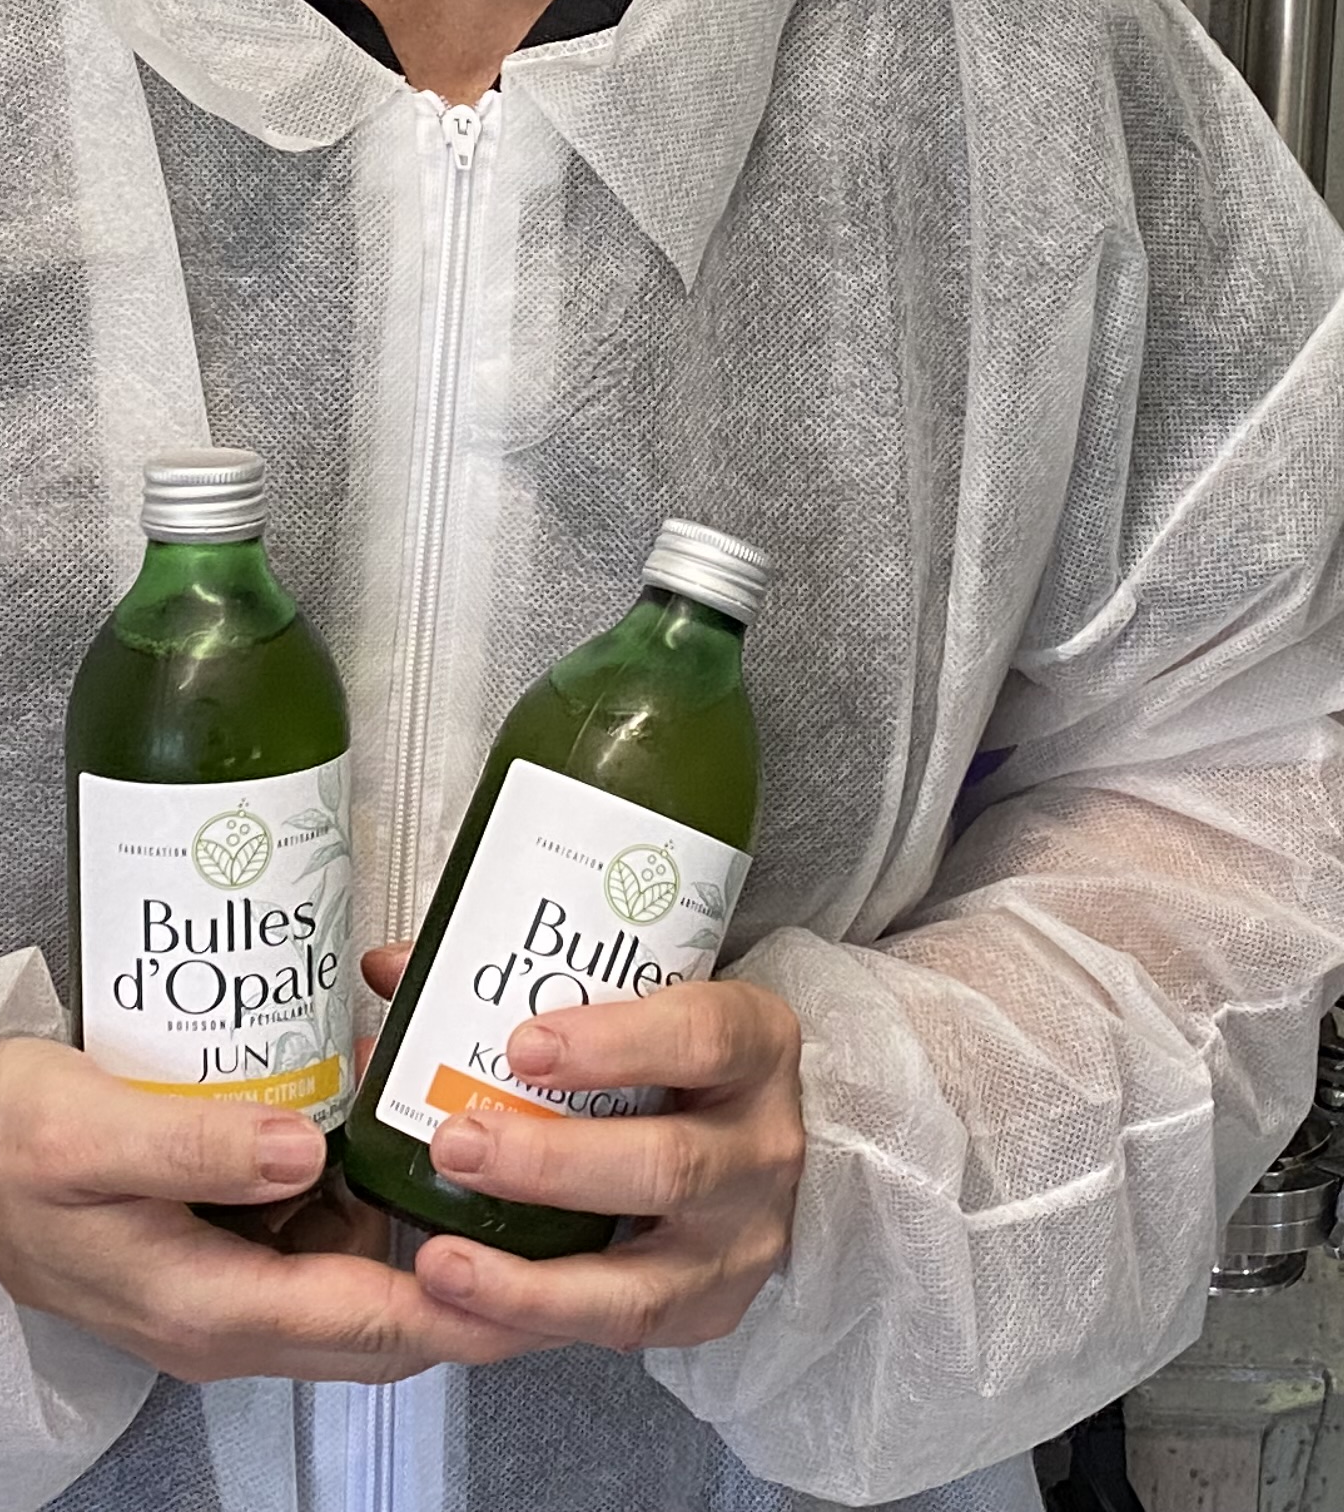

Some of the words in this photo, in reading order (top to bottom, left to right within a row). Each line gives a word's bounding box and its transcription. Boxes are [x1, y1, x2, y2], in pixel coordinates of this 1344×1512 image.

[118, 843, 187, 858] FABRICATION
[535, 835, 605, 872] FABRICATION
[143, 898, 316, 954] Bulles
[114, 945, 338, 1028] d'Opale
[168, 1020, 226, 1032] BOISSON
[198, 1042, 270, 1083] JUN
[264, 1076, 315, 1105] CITRON
